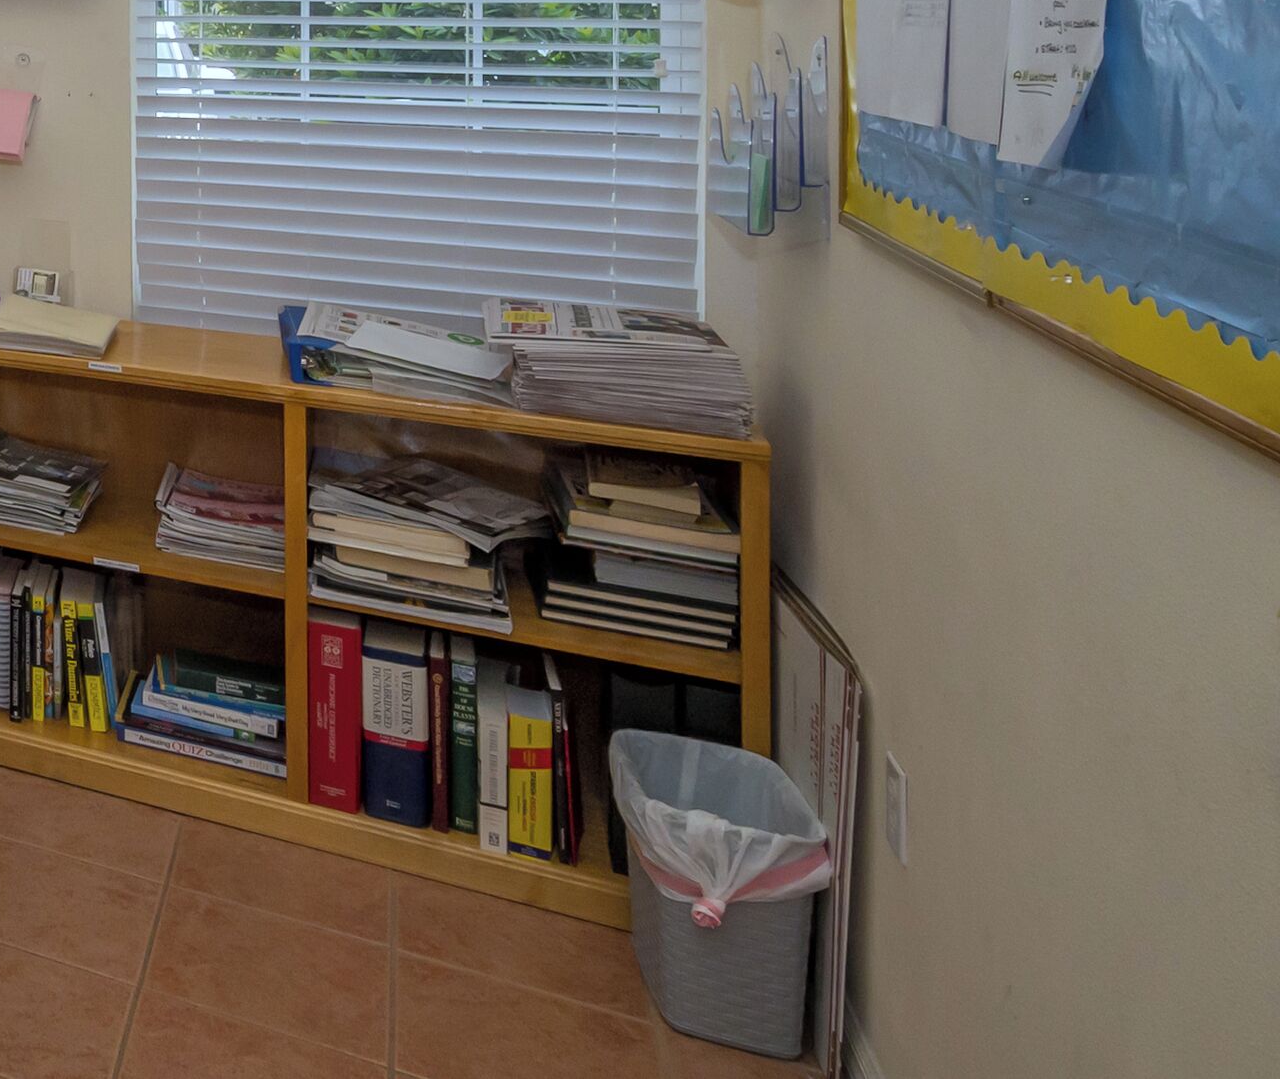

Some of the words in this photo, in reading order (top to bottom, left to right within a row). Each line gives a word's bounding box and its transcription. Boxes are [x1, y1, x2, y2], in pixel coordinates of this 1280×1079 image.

[64, 619, 74, 641] Wine
[66, 642, 75, 659] For
[373, 666, 381, 727] DICTIONARY
[384, 668, 392, 729] UNABRIDGED
[402, 670, 413, 735] WEBSTER'S
[139, 735, 170, 748] Amazing
[172, 742, 204, 755] QUIZ
